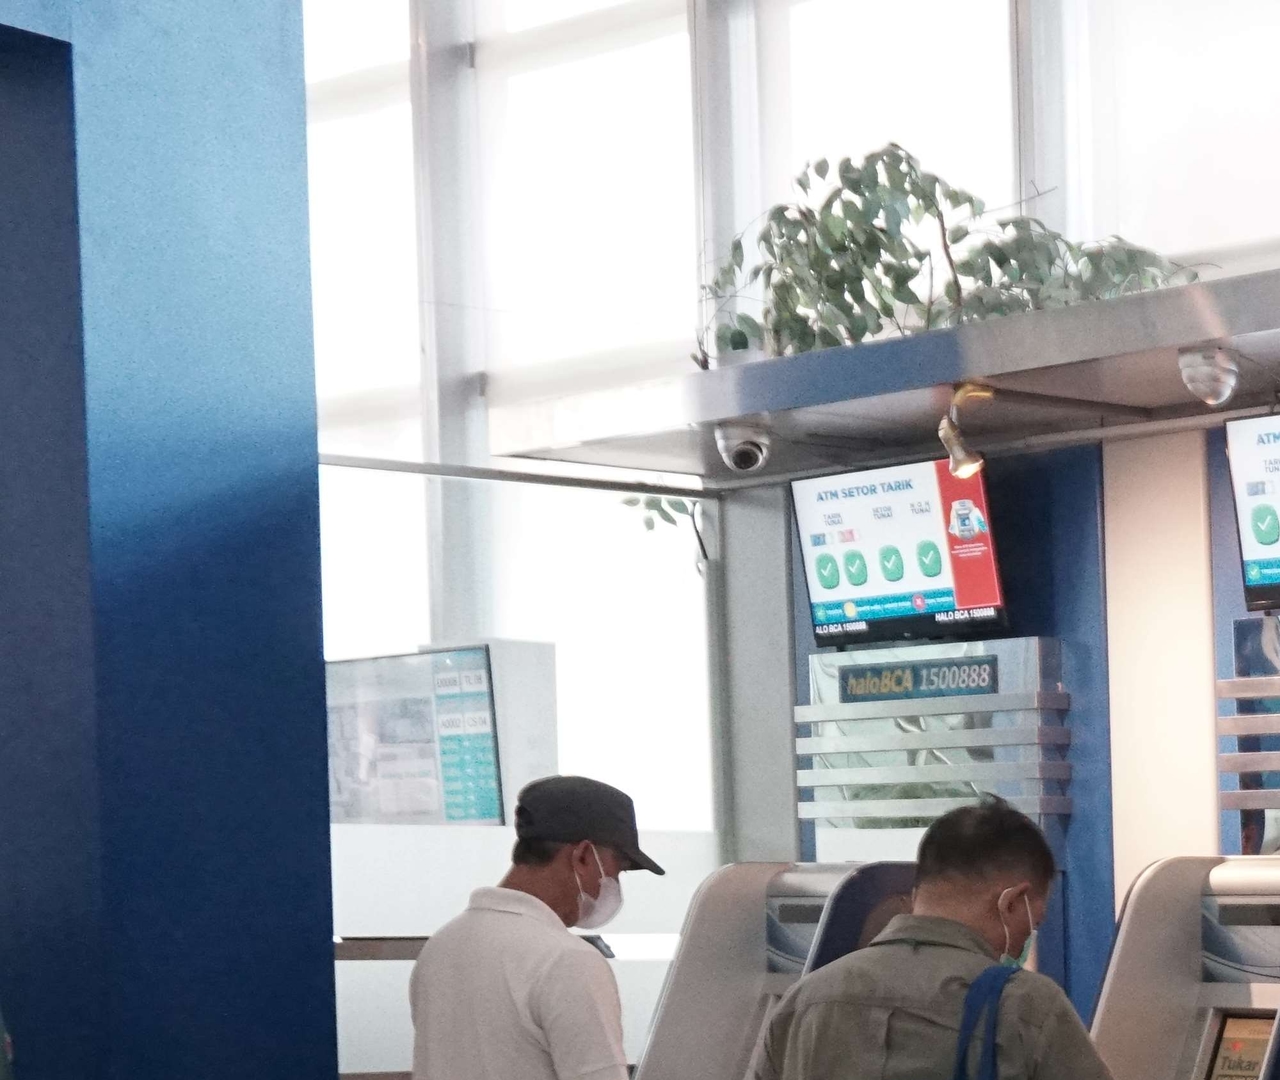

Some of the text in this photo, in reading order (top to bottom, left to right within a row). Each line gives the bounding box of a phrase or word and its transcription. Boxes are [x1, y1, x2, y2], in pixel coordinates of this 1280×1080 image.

[816, 478, 914, 502] ATM SETOR TARIK
[846, 663, 991, 695] haloBCA 1500888
